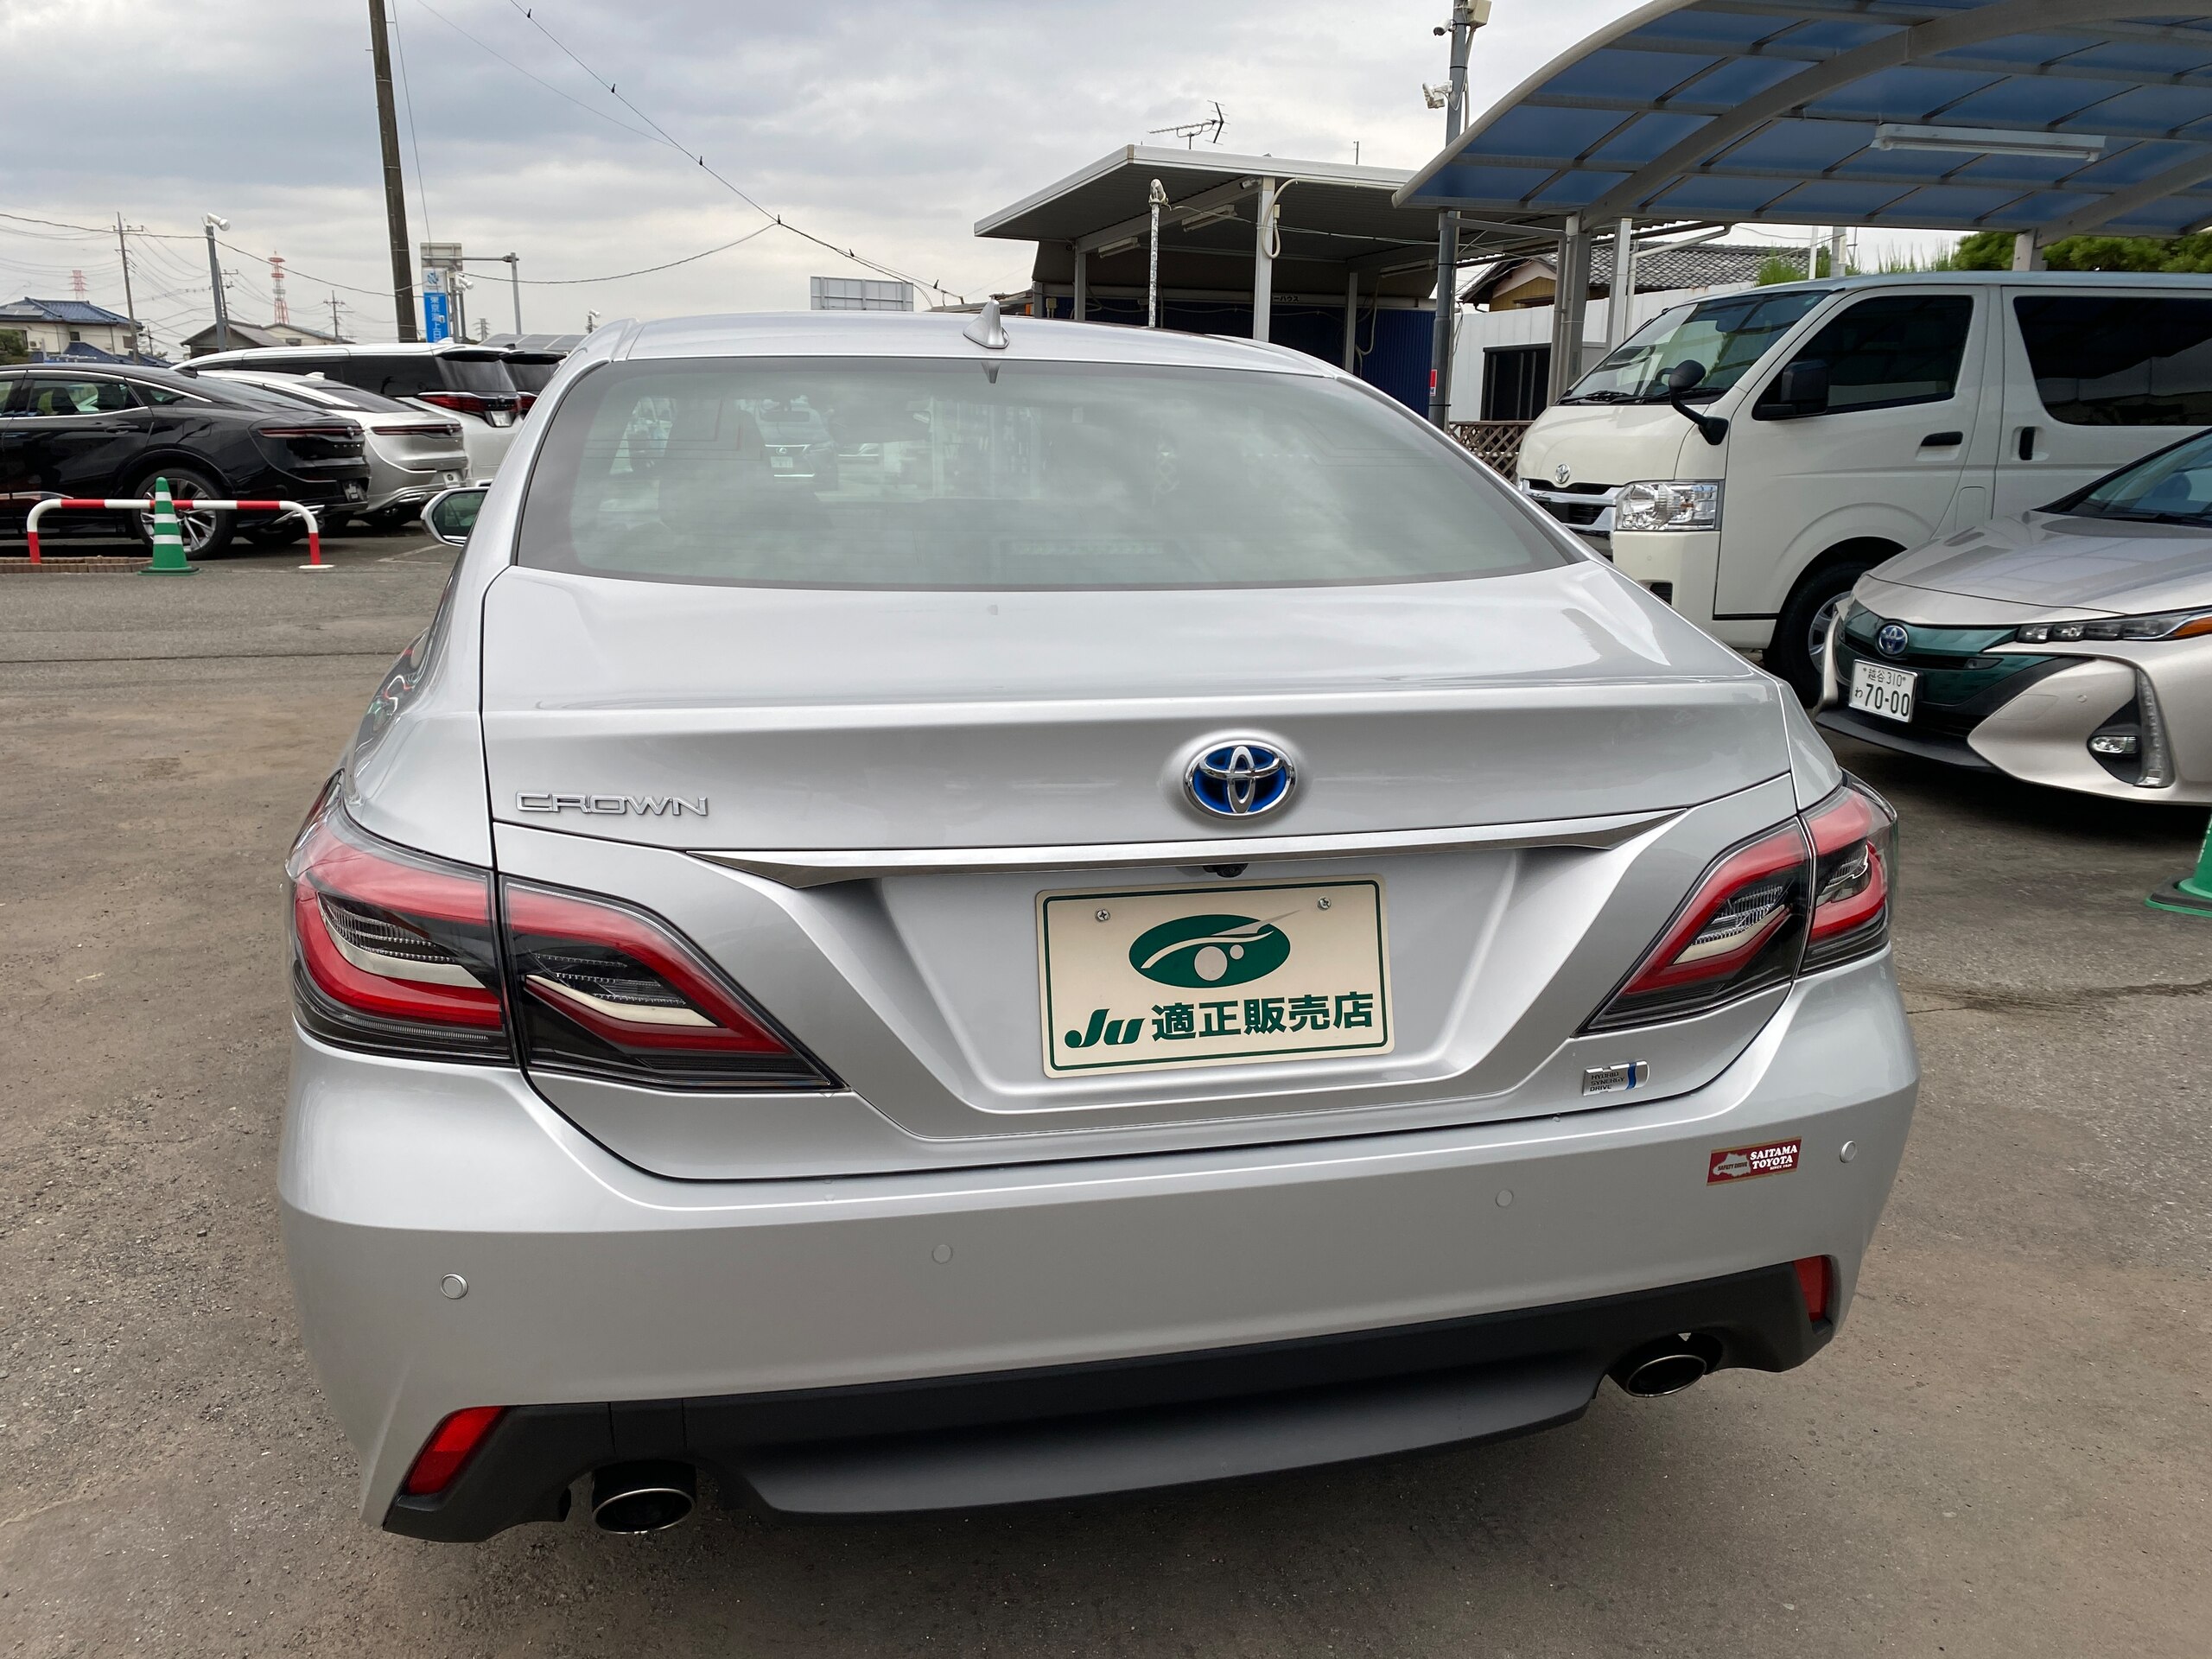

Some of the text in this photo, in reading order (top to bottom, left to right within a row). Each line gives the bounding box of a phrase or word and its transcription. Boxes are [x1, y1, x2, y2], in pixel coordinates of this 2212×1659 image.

[1868, 668, 1903, 687] 越谷 310
[1854, 683, 1910, 717] わ 70-00
[516, 791, 709, 816] CROWN
[1151, 990, 1375, 1042] 適正販売店
[1591, 1071, 1619, 1080] HYBRID
[1750, 1144, 1797, 1160] SAITAMA
[1751, 1155, 1793, 1170] TOYOTA
